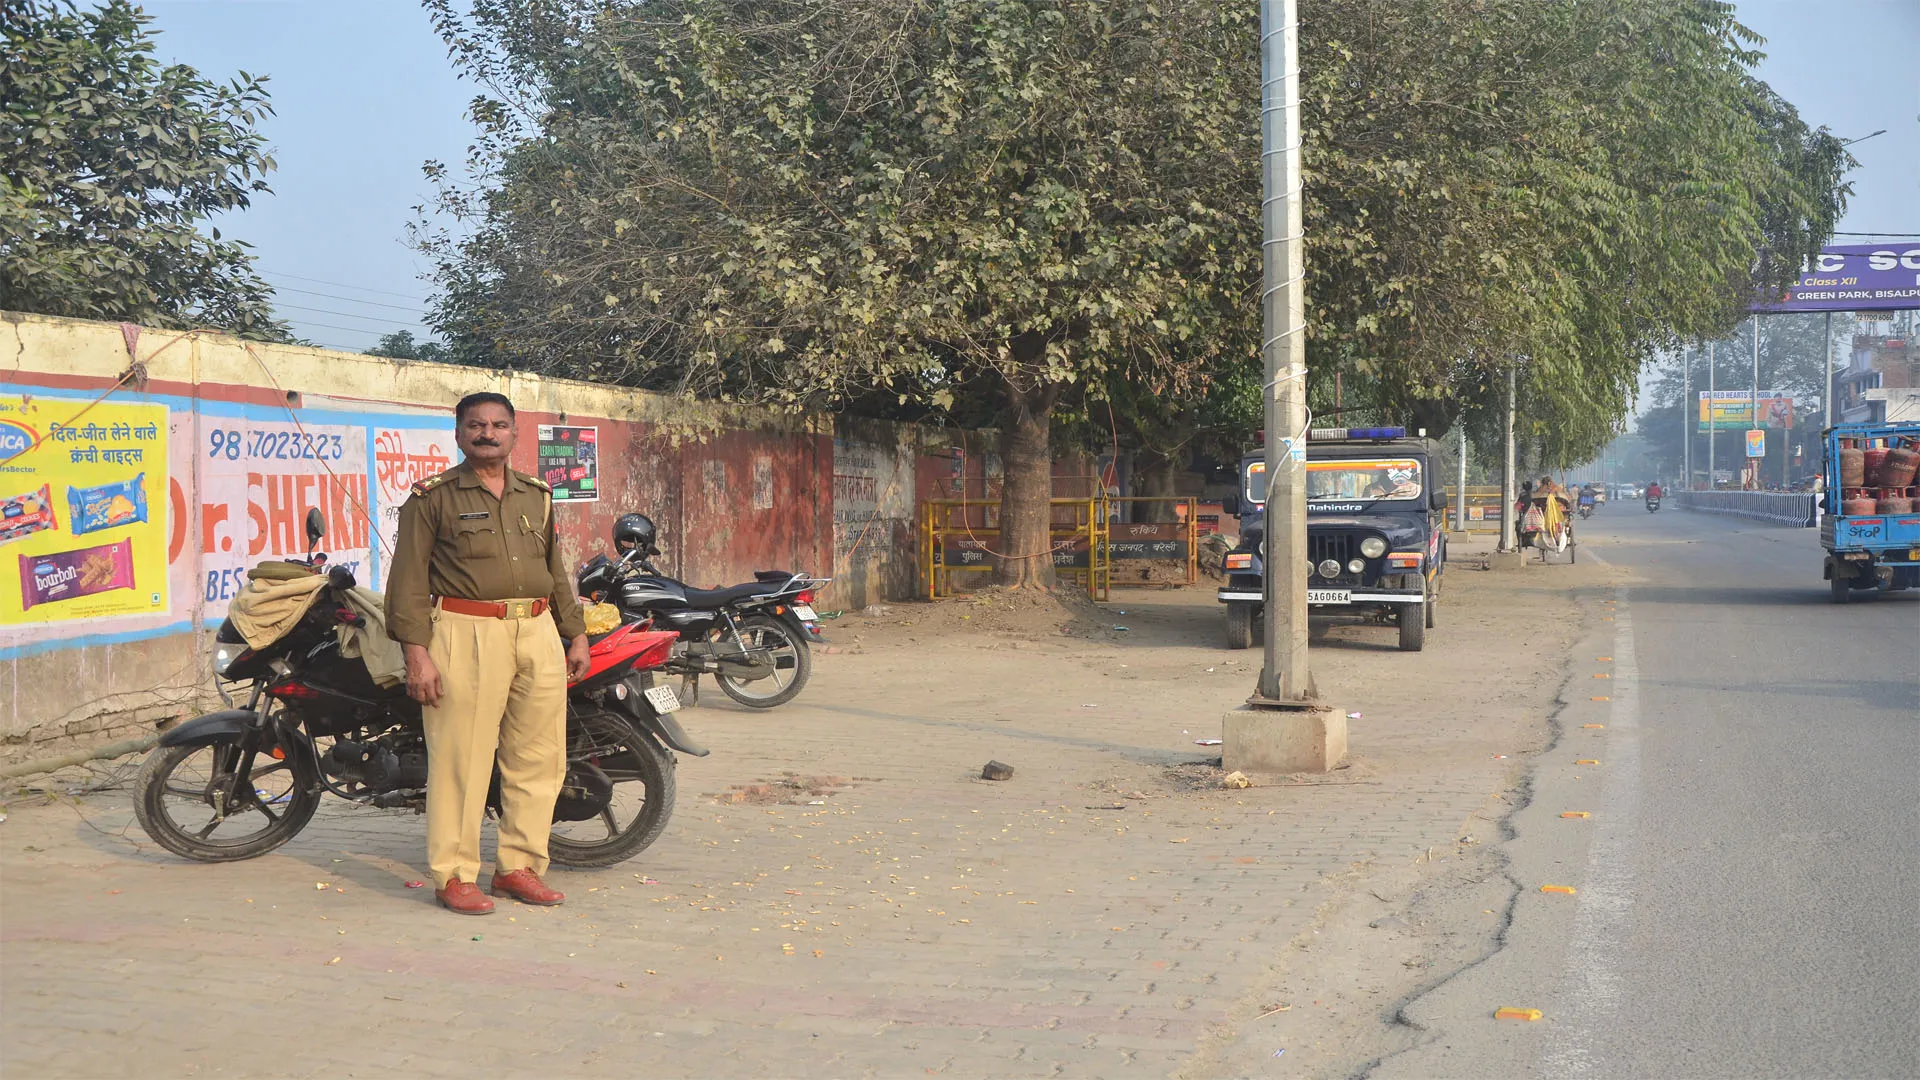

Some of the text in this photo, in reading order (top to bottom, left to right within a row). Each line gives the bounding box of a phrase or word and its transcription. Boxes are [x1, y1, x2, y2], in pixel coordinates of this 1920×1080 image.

[1804, 277, 1837, 286] Class
[1797, 291, 1835, 300] GREEN
[1838, 291, 1873, 299] PARK,
[1702, 391, 1772, 399] SARED HEARTS SHOOL
[110, 422, 130, 441] लेने
[133, 421, 157, 440] वाले
[247, 472, 369, 555] SHEIKH
[35, 566, 77, 591] bourbon
